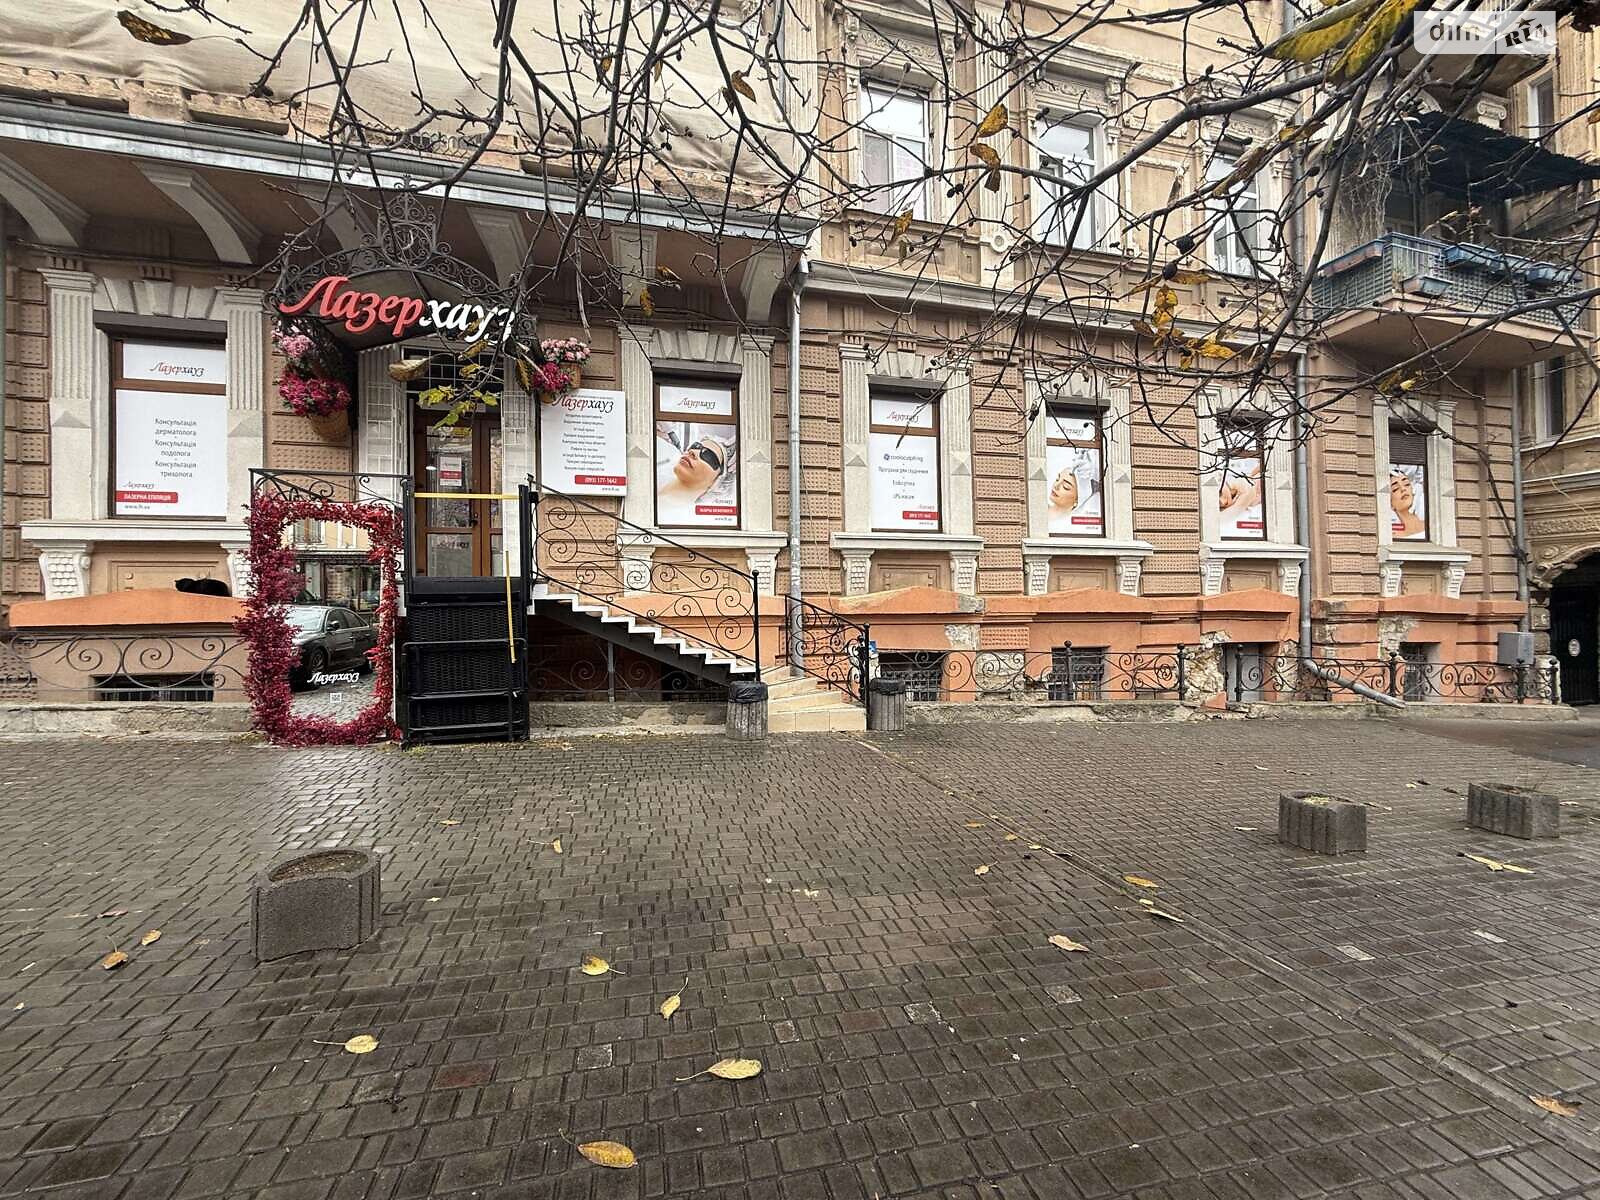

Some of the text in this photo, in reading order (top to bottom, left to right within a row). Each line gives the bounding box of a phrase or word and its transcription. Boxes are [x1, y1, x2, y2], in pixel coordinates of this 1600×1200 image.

[279, 275, 516, 345] Лазерхауз
[149, 361, 205, 378] Лазерхауз
[552, 394, 614, 414] Лазерхауз
[154, 418, 197, 429] Консультація
[154, 428, 197, 437] дерматолога
[154, 439, 197, 450] Консультація
[160, 450, 191, 458] подолога
[154, 461, 197, 470] Консультація
[160, 470, 193, 479] трихолога
[307, 671, 359, 684] Лазерхауз
